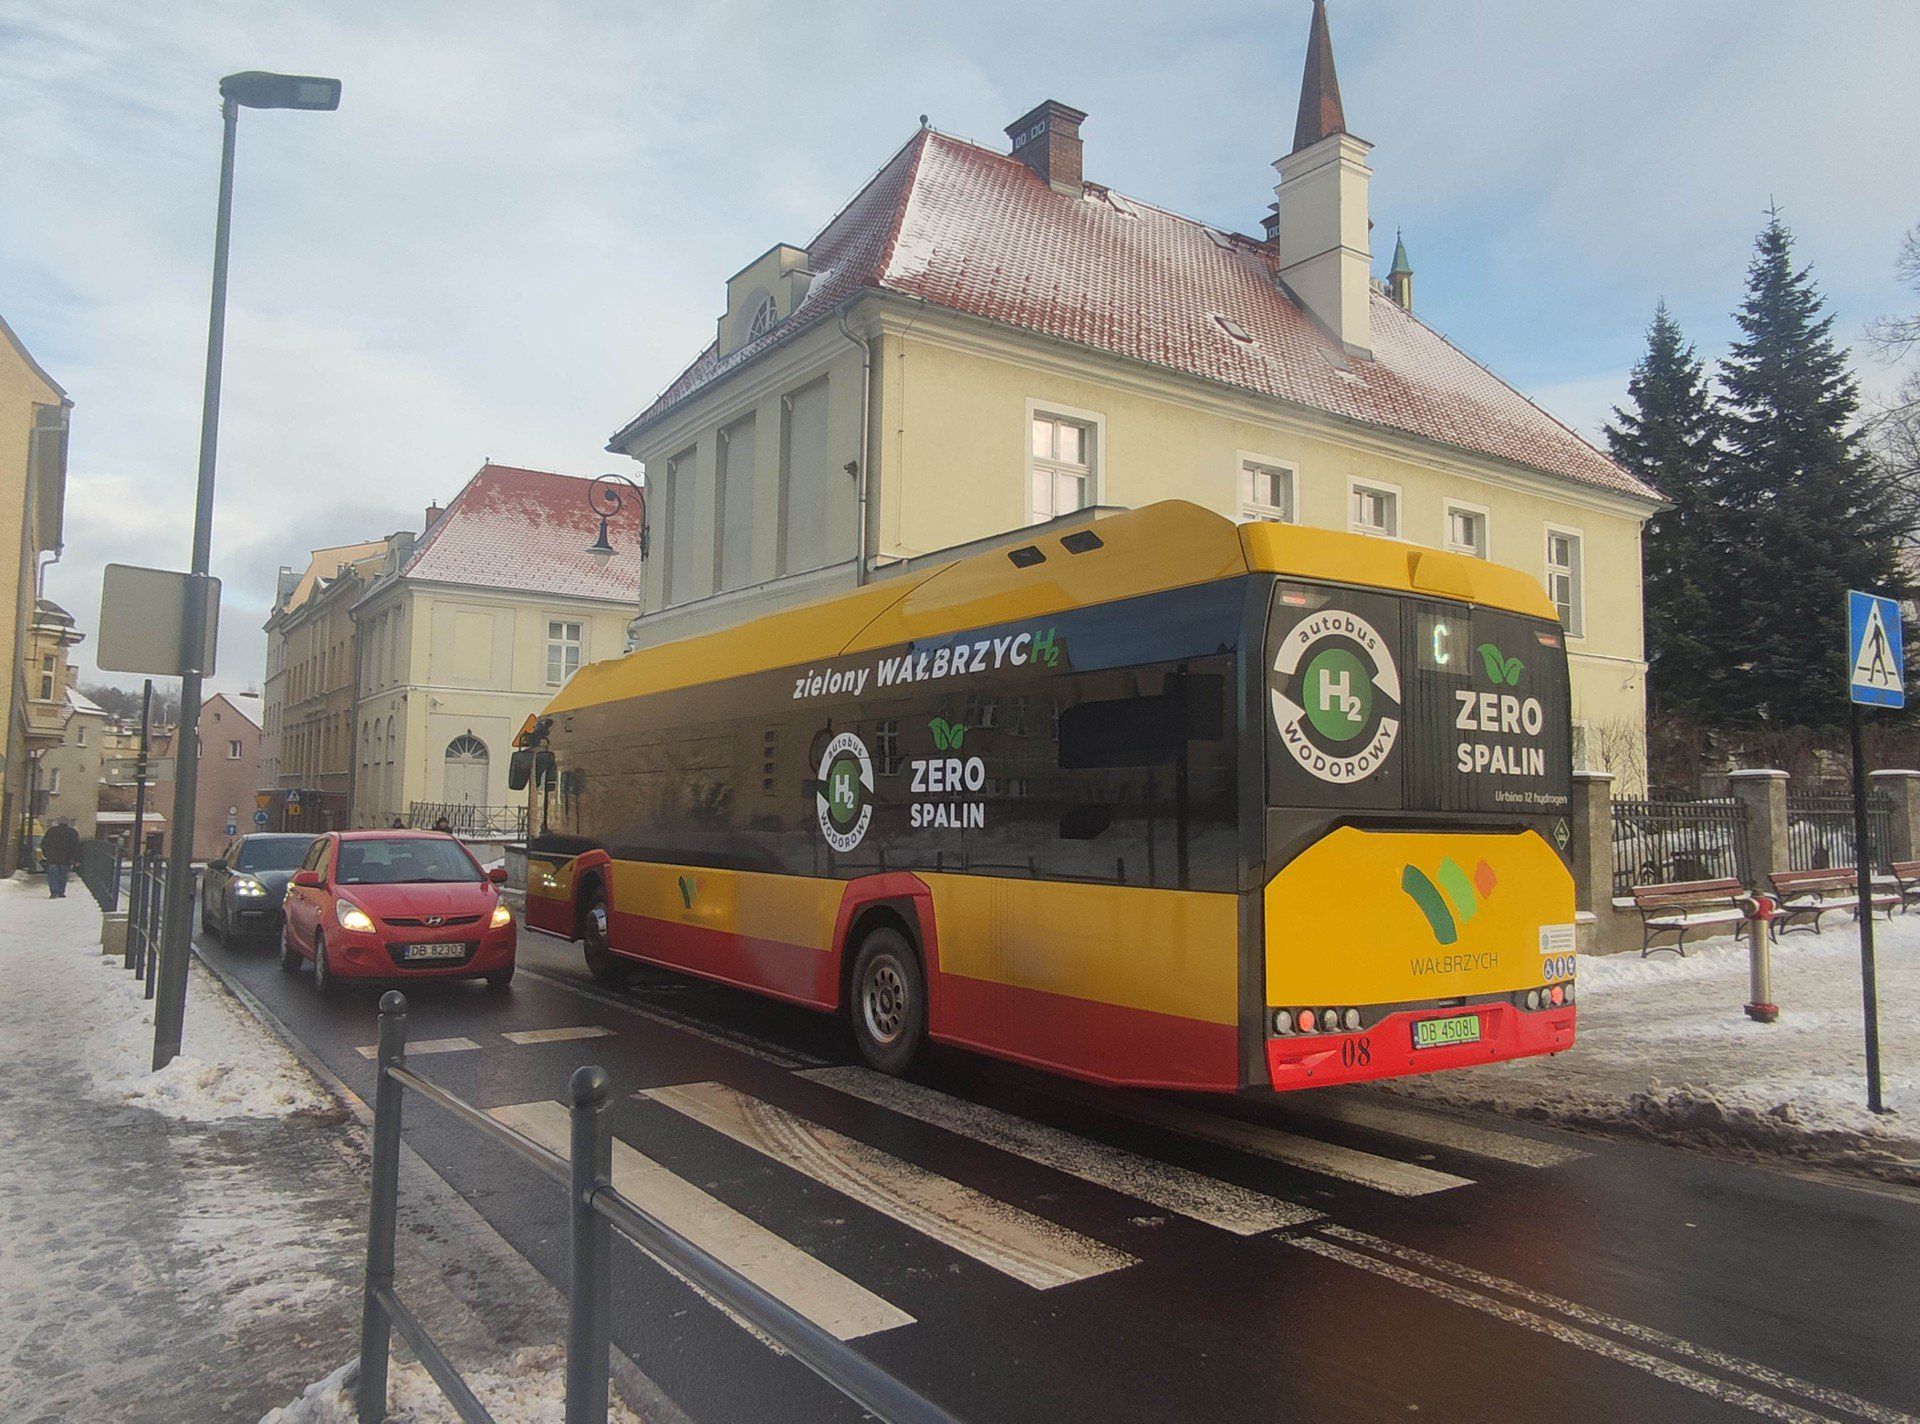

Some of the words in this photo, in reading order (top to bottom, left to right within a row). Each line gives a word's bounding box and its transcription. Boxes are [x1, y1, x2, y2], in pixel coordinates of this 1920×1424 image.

[1298, 617, 1377, 651] autobus
[793, 665, 870, 699] zielony
[1455, 689, 1543, 736] ZERO
[828, 737, 864, 759] autobus
[1284, 719, 1393, 777] WODOROWY
[1457, 744, 1545, 777] SPALIN
[910, 756, 986, 793] ZERO
[1495, 790, 1523, 803] Urbino
[1524, 791, 1533, 803] 12
[1533, 793, 1568, 806] hydrogen
[820, 810, 870, 849] WODOROWY
[910, 802, 985, 829] SPALIN
[411, 945, 427, 957] DB
[431, 944, 464, 956] 82303
[1410, 951, 1498, 976] WAŁBRZYCH
[1420, 1023, 1437, 1042] DB
[1441, 1018, 1477, 1040] 4508L
[1340, 1036, 1372, 1069] 08
